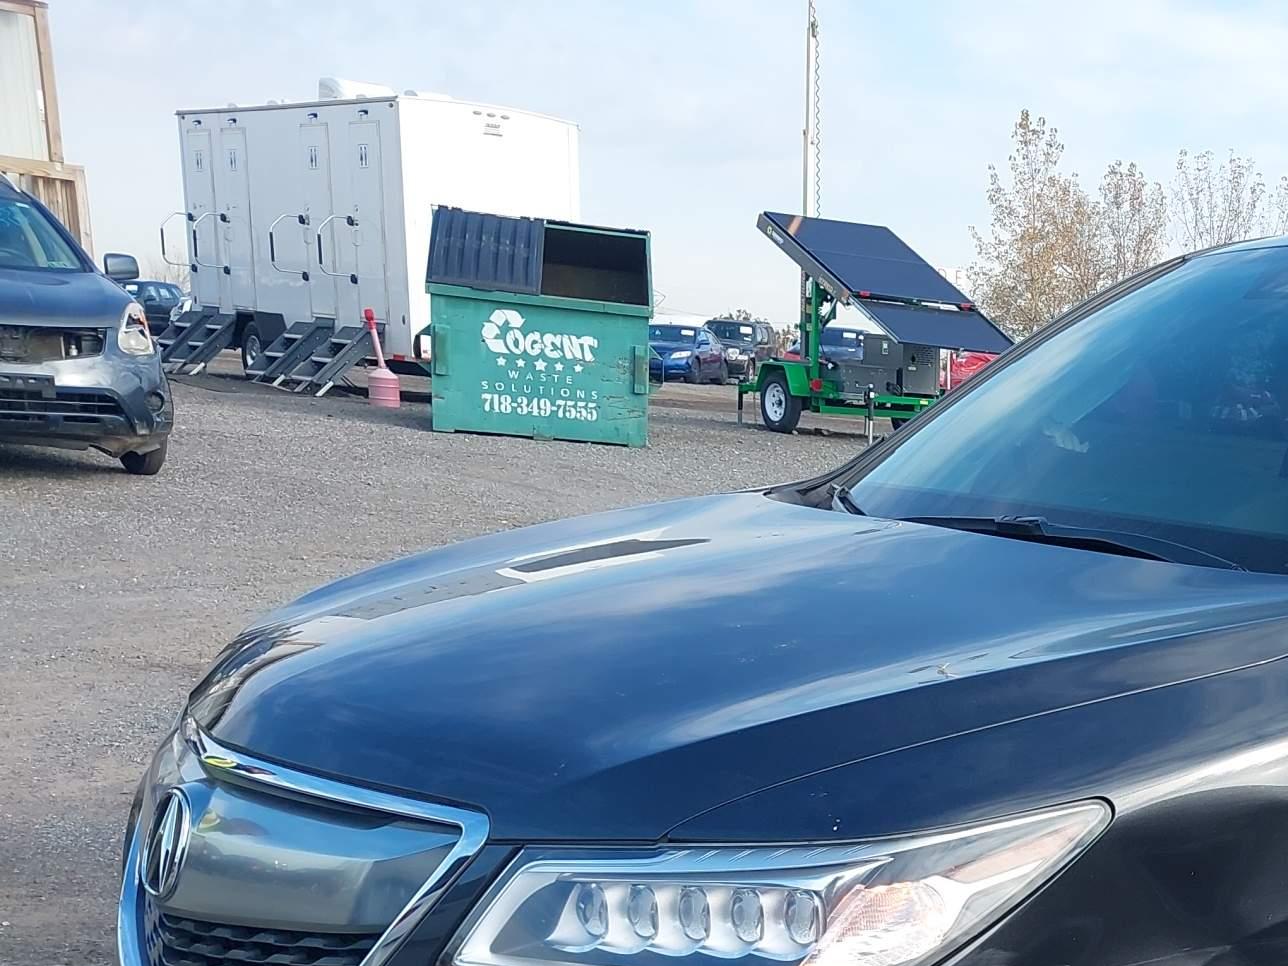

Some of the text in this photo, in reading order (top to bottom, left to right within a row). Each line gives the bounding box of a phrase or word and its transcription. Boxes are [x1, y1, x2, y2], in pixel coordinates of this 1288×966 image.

[507, 370, 573, 384] WASTE
[481, 380, 598, 400] SOLUTIONS
[481, 393, 598, 422] 718-349-7555
